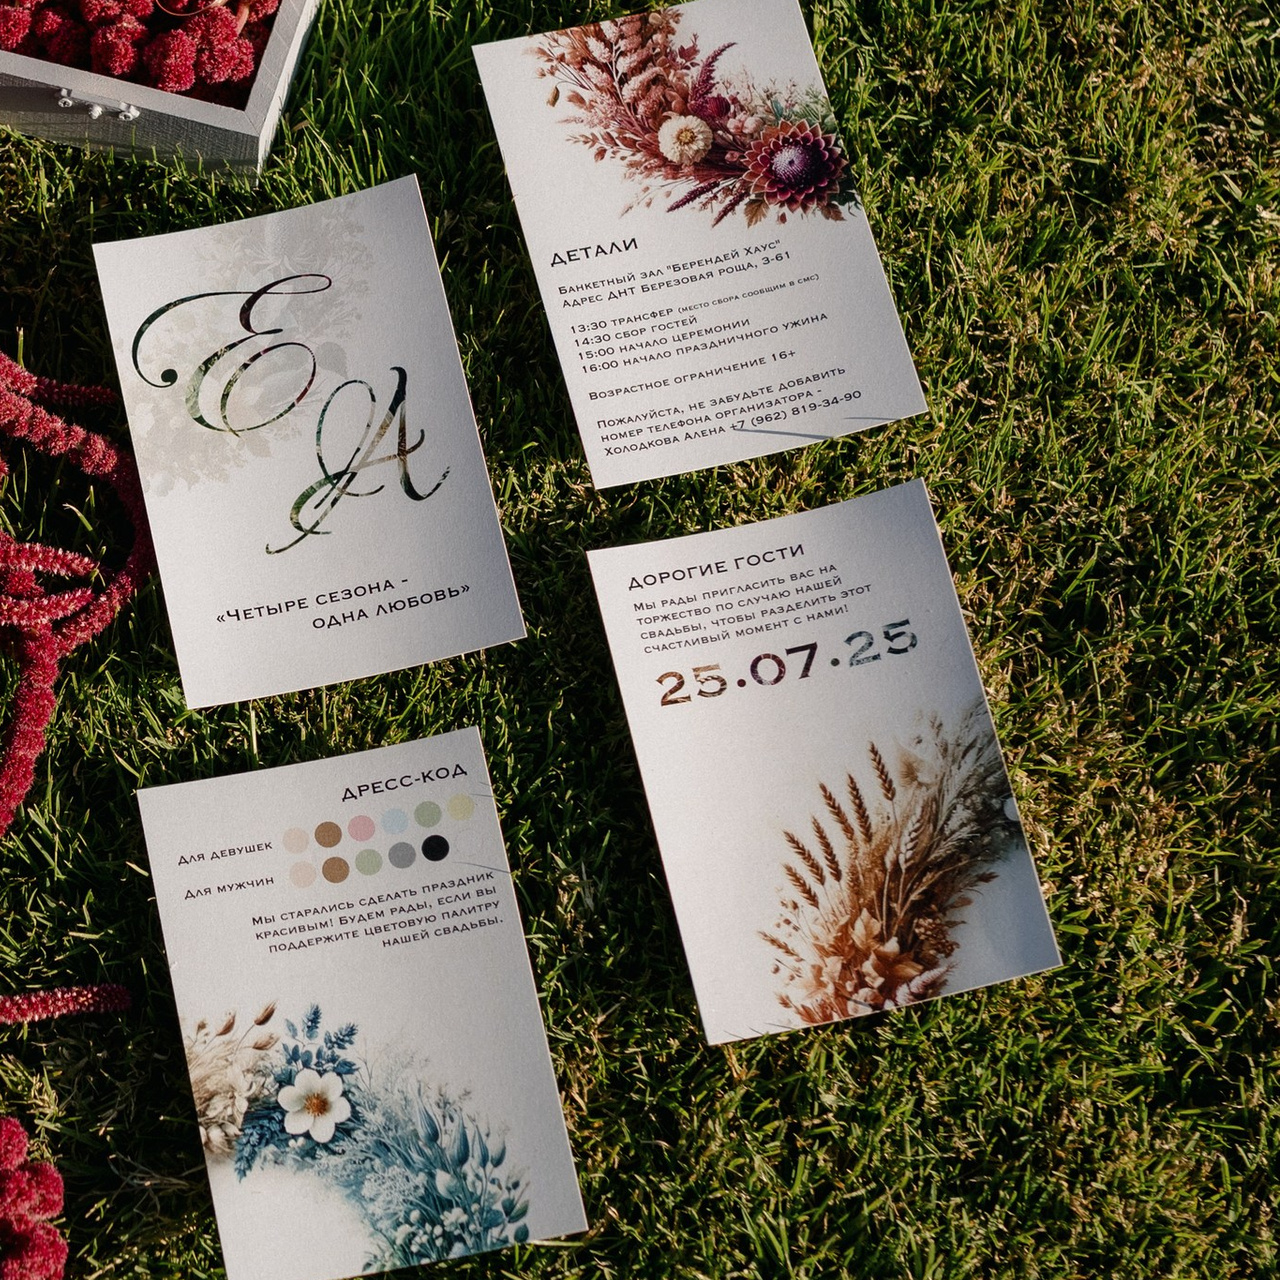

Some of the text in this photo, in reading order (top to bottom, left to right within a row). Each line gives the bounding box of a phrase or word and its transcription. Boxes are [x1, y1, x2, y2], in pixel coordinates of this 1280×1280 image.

[761, 251, 790, 265] 3-61
[571, 320, 607, 334] 13:30
[574, 333, 611, 347] 14:30
[578, 347, 615, 360] 15:00
[772, 350, 796, 361] 16+
[582, 360, 619, 374] 16:00
[729, 419, 747, 431] +7
[751, 410, 787, 427] (962)
[791, 390, 863, 417] 819-34-90
[655, 618, 918, 706] 25.07.25
